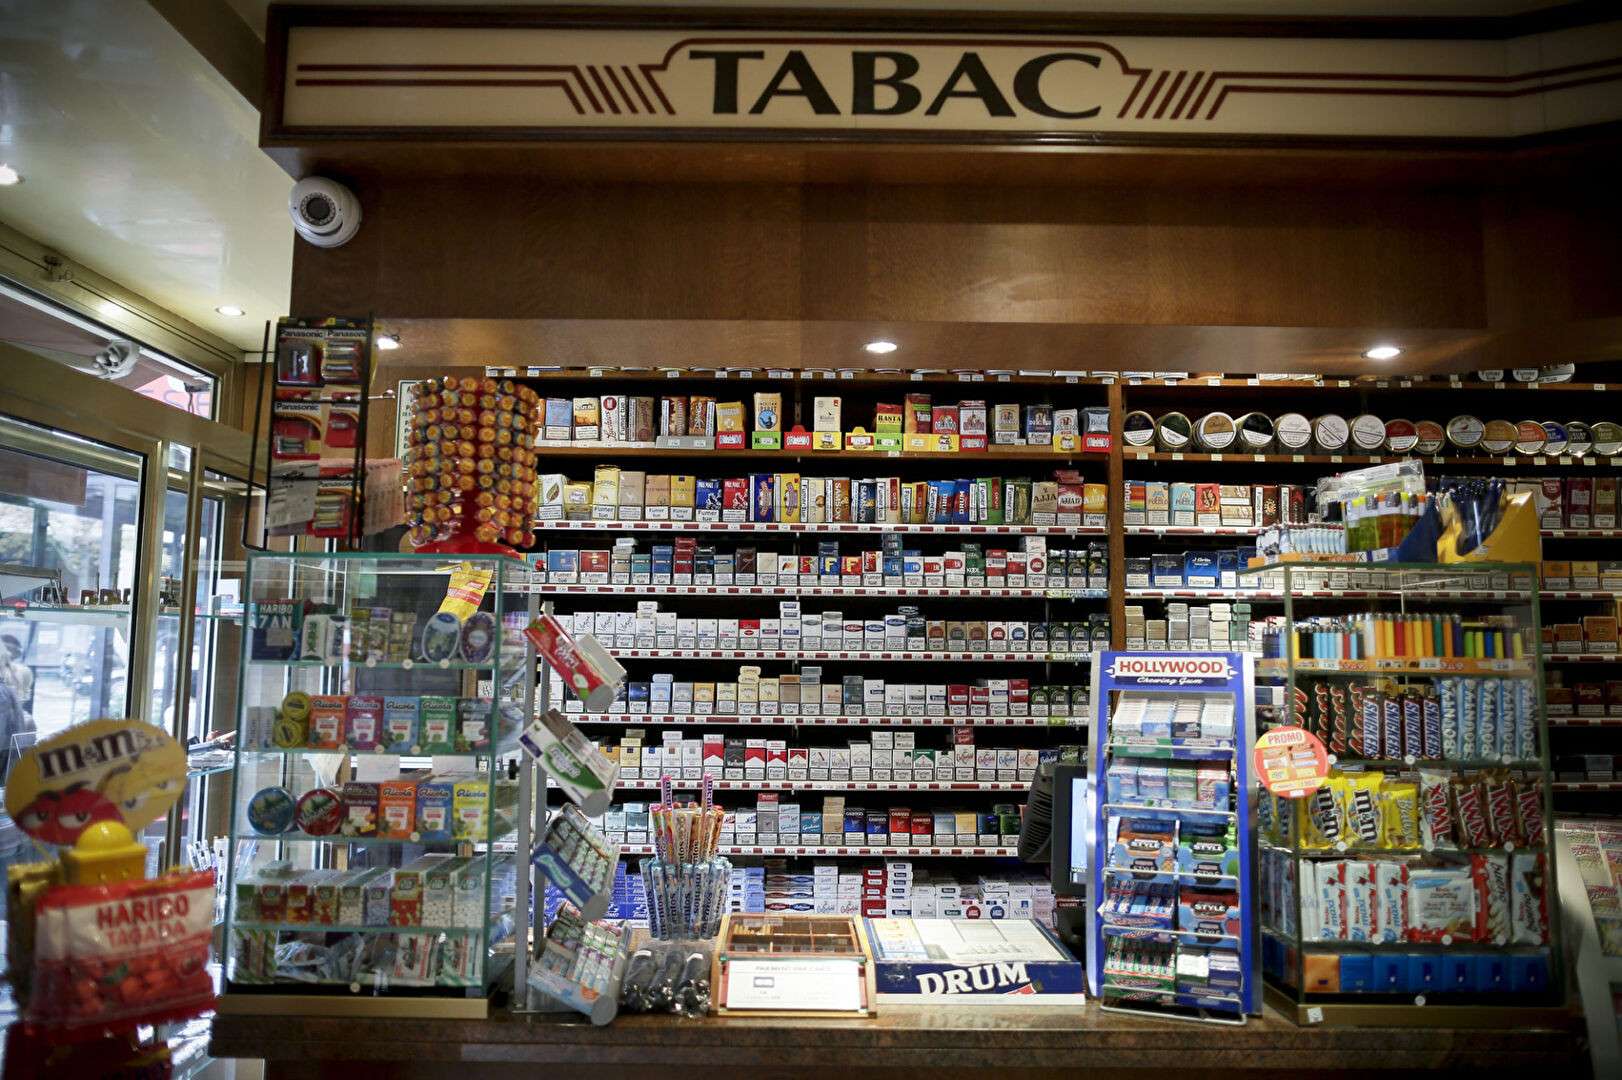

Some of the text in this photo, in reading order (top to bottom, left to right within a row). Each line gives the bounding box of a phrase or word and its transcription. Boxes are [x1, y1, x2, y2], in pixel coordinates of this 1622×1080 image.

[689, 50, 1101, 118] TABAC
[279, 329, 324, 338] Panasonic
[276, 402, 320, 411] Panasonic
[259, 604, 293, 614] HARIBO
[259, 614, 292, 629] ZAN
[1119, 660, 1224, 674] HOLLYWOOD
[1137, 677, 1204, 685] Chewing Gum
[312, 699, 345, 710] Ricola
[385, 700, 416, 711] Ricola
[1267, 731, 1303, 744] PROMO
[1365, 702, 1378, 758] SNICKERS
[1386, 702, 1400, 759] SNICKERS
[1405, 702, 1421, 758] SNICKERS
[1425, 701, 1441, 759] SNICKERS
[382, 787, 415, 798] Ricola
[1429, 784, 1450, 837] TWIX
[1460, 785, 1485, 847] TWIX
[1491, 785, 1512, 842] TWIX
[1519, 790, 1542, 843] TWIX
[1129, 839, 1161, 849] STYLE
[1193, 842, 1224, 852] STYLE
[97, 893, 190, 930] HARIBO
[1194, 902, 1227, 912] STYLE
[107, 922, 187, 948] TAGADA
[916, 963, 1031, 995] DRUM
